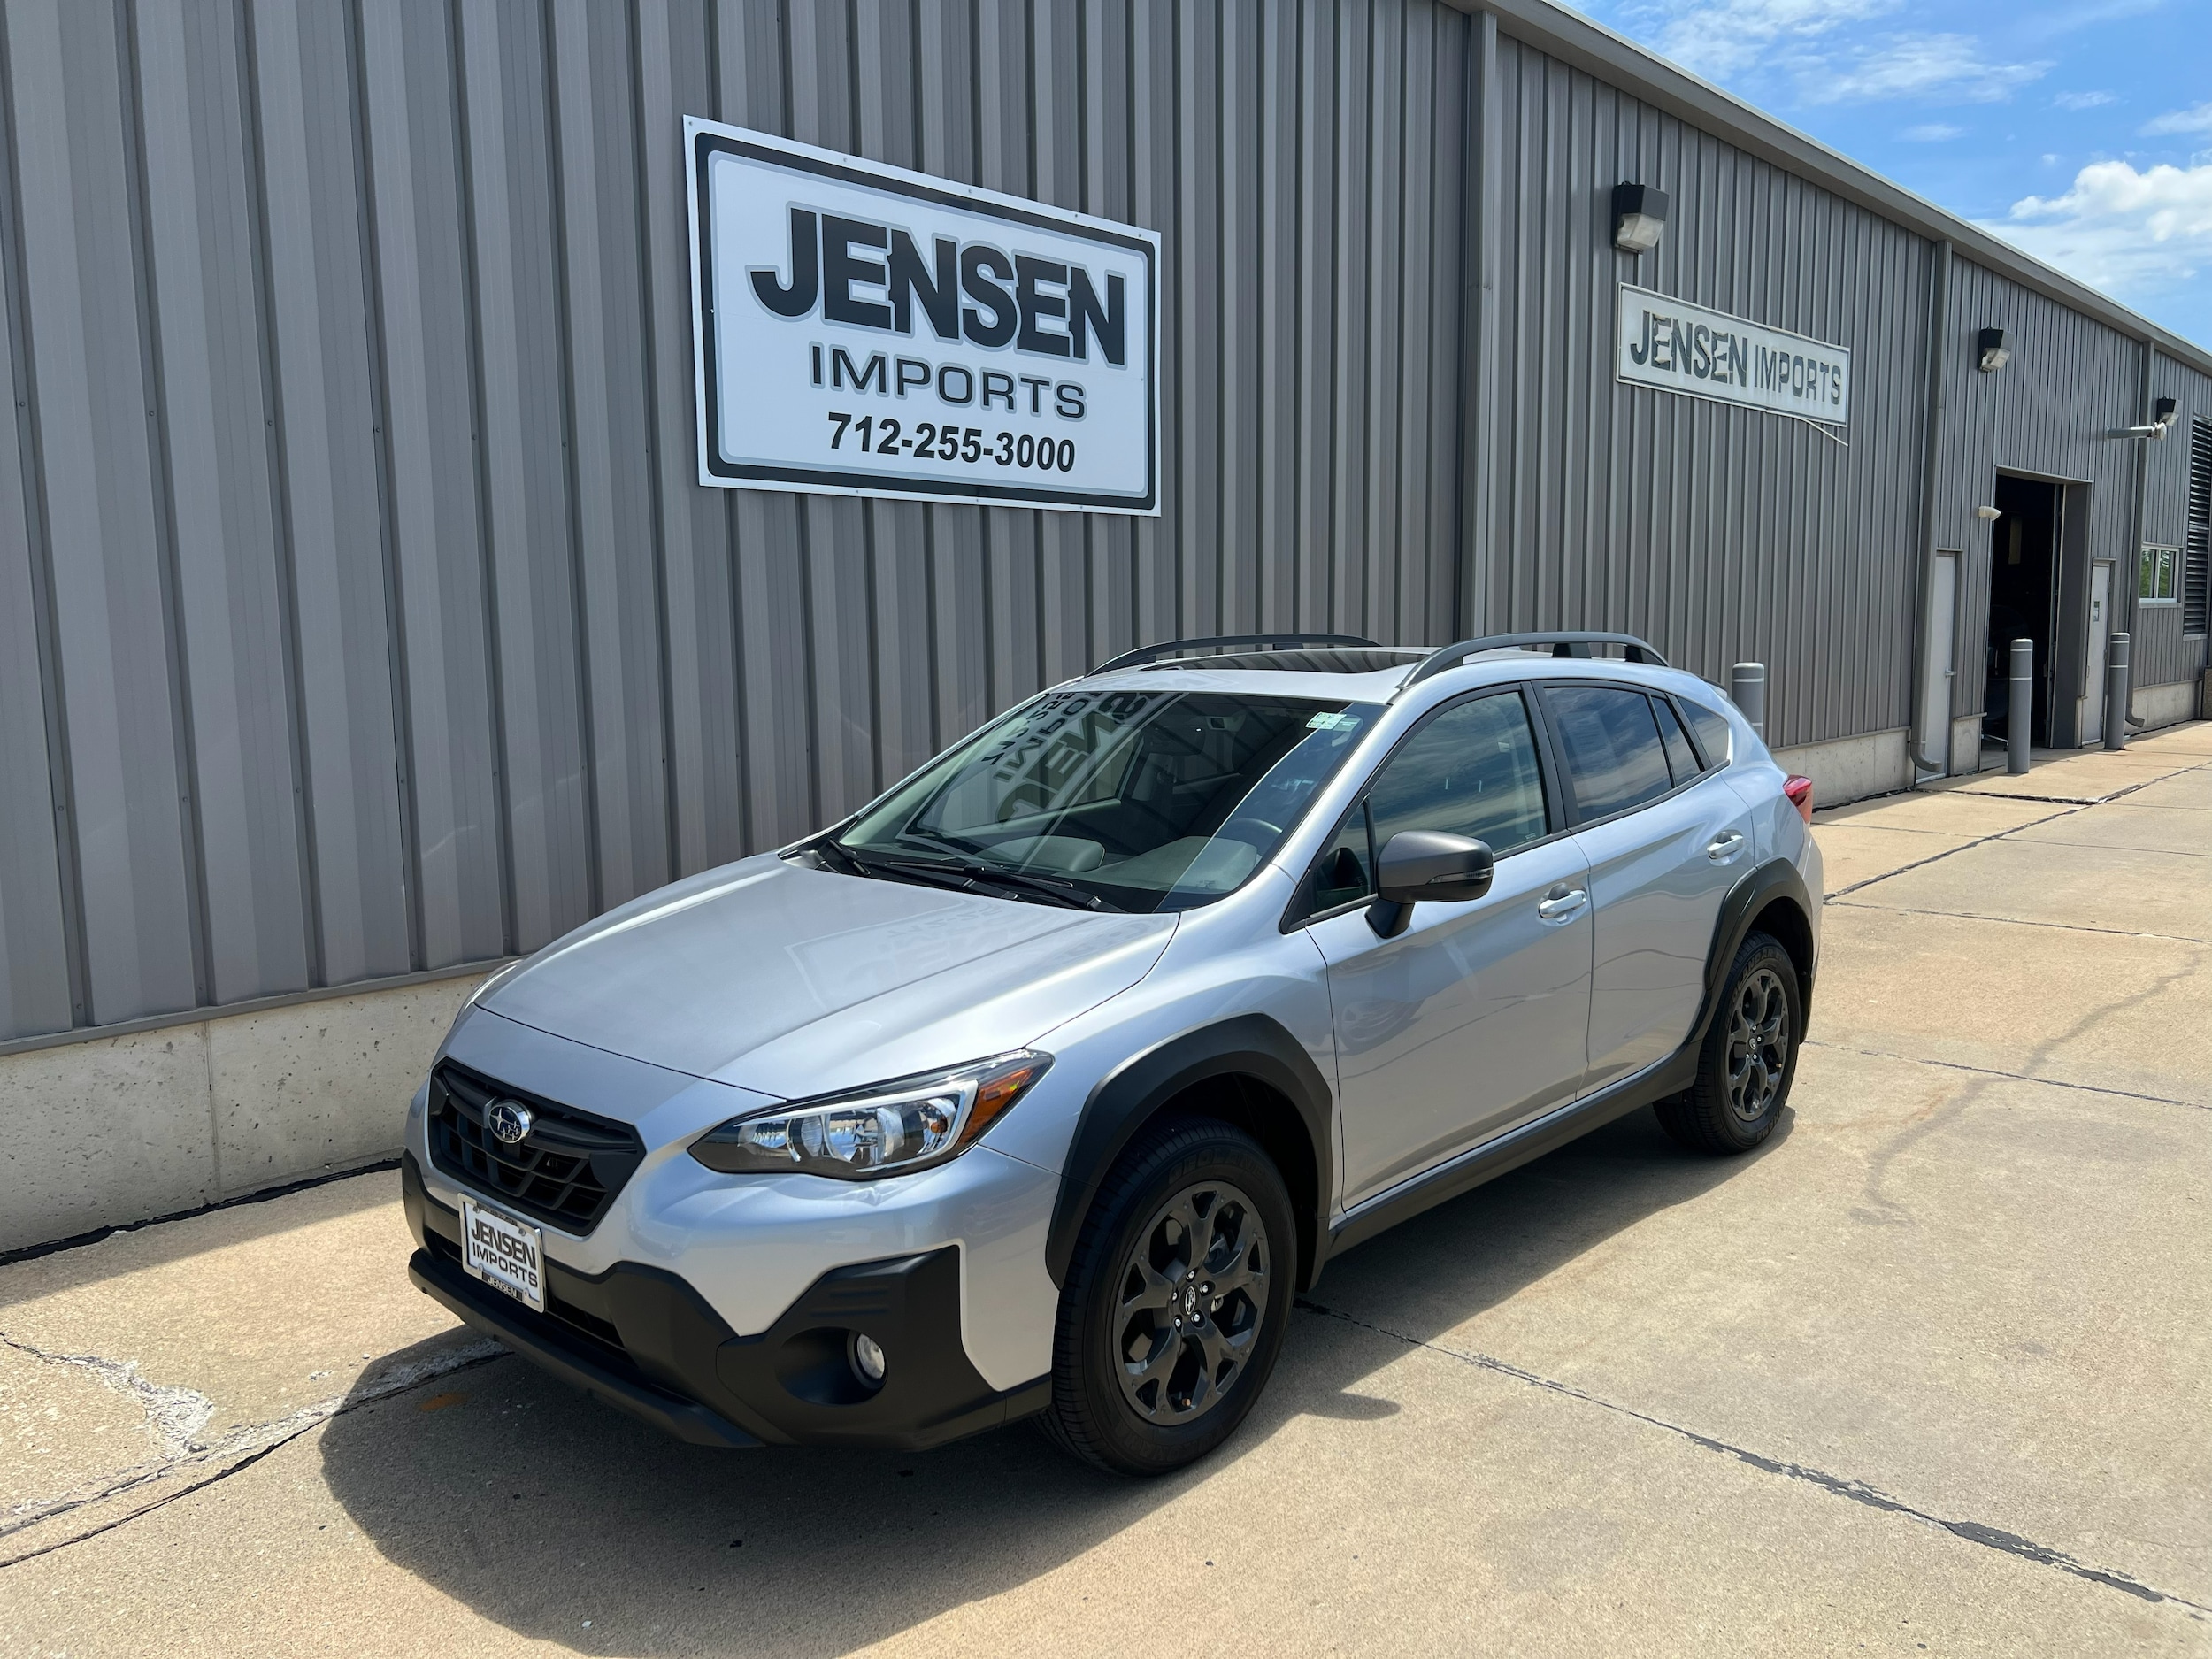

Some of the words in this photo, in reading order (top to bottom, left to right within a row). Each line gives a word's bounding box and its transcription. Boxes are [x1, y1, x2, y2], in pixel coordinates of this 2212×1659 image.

[749, 204, 1127, 369] JENSEN
[810, 345, 1086, 419] IMPORTS
[1630, 310, 1747, 388] JENSEN
[1755, 344, 1841, 405] IMPORTS
[827, 411, 1075, 472] 712-255-3000
[472, 1219, 536, 1270] JENSEN
[472, 1242, 538, 1287] IMPORTS
[488, 1277, 518, 1298] JENSEN
